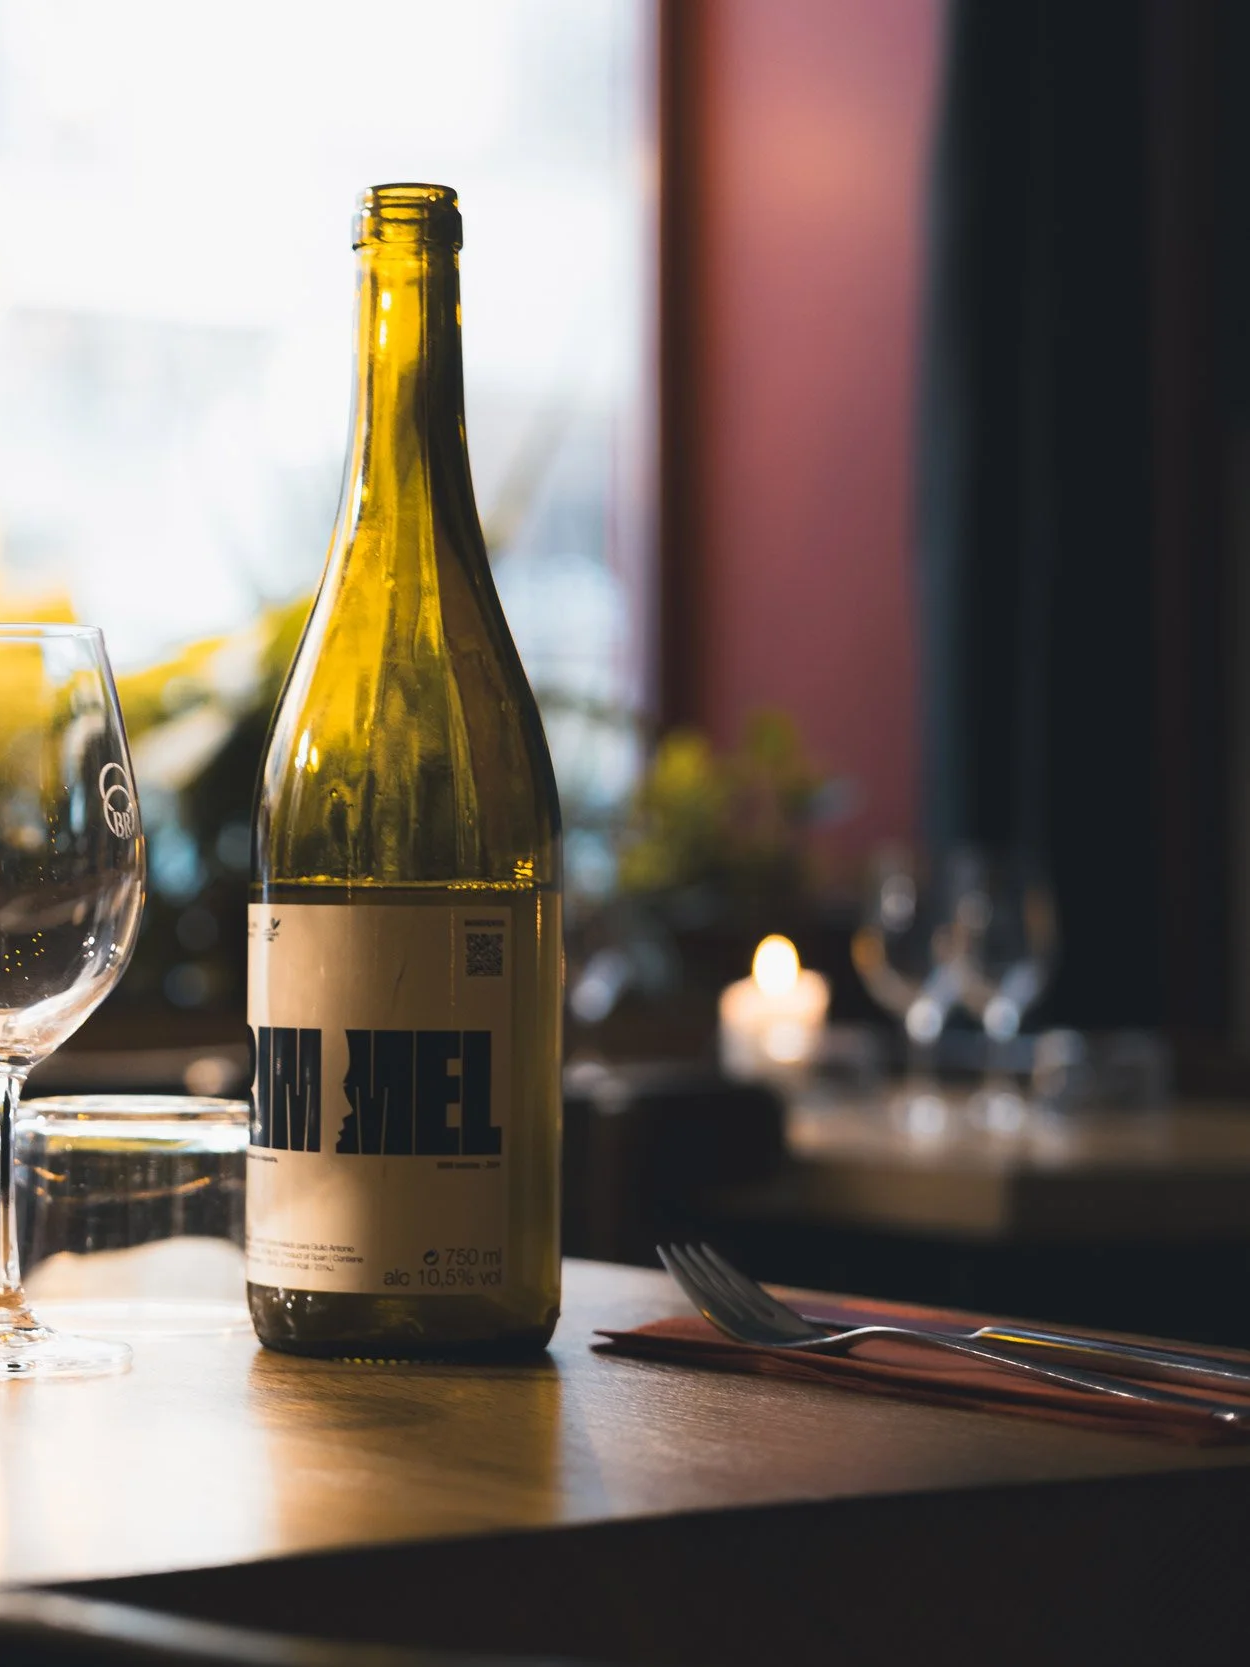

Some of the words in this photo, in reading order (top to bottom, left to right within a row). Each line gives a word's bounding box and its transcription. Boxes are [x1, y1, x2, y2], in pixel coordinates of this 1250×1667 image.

[445, 1247, 479, 1266] 750
[483, 1246, 502, 1266] ml
[383, 1268, 411, 1286] alc
[417, 1268, 475, 1288] 10,5%
[479, 1268, 502, 1286] vol
